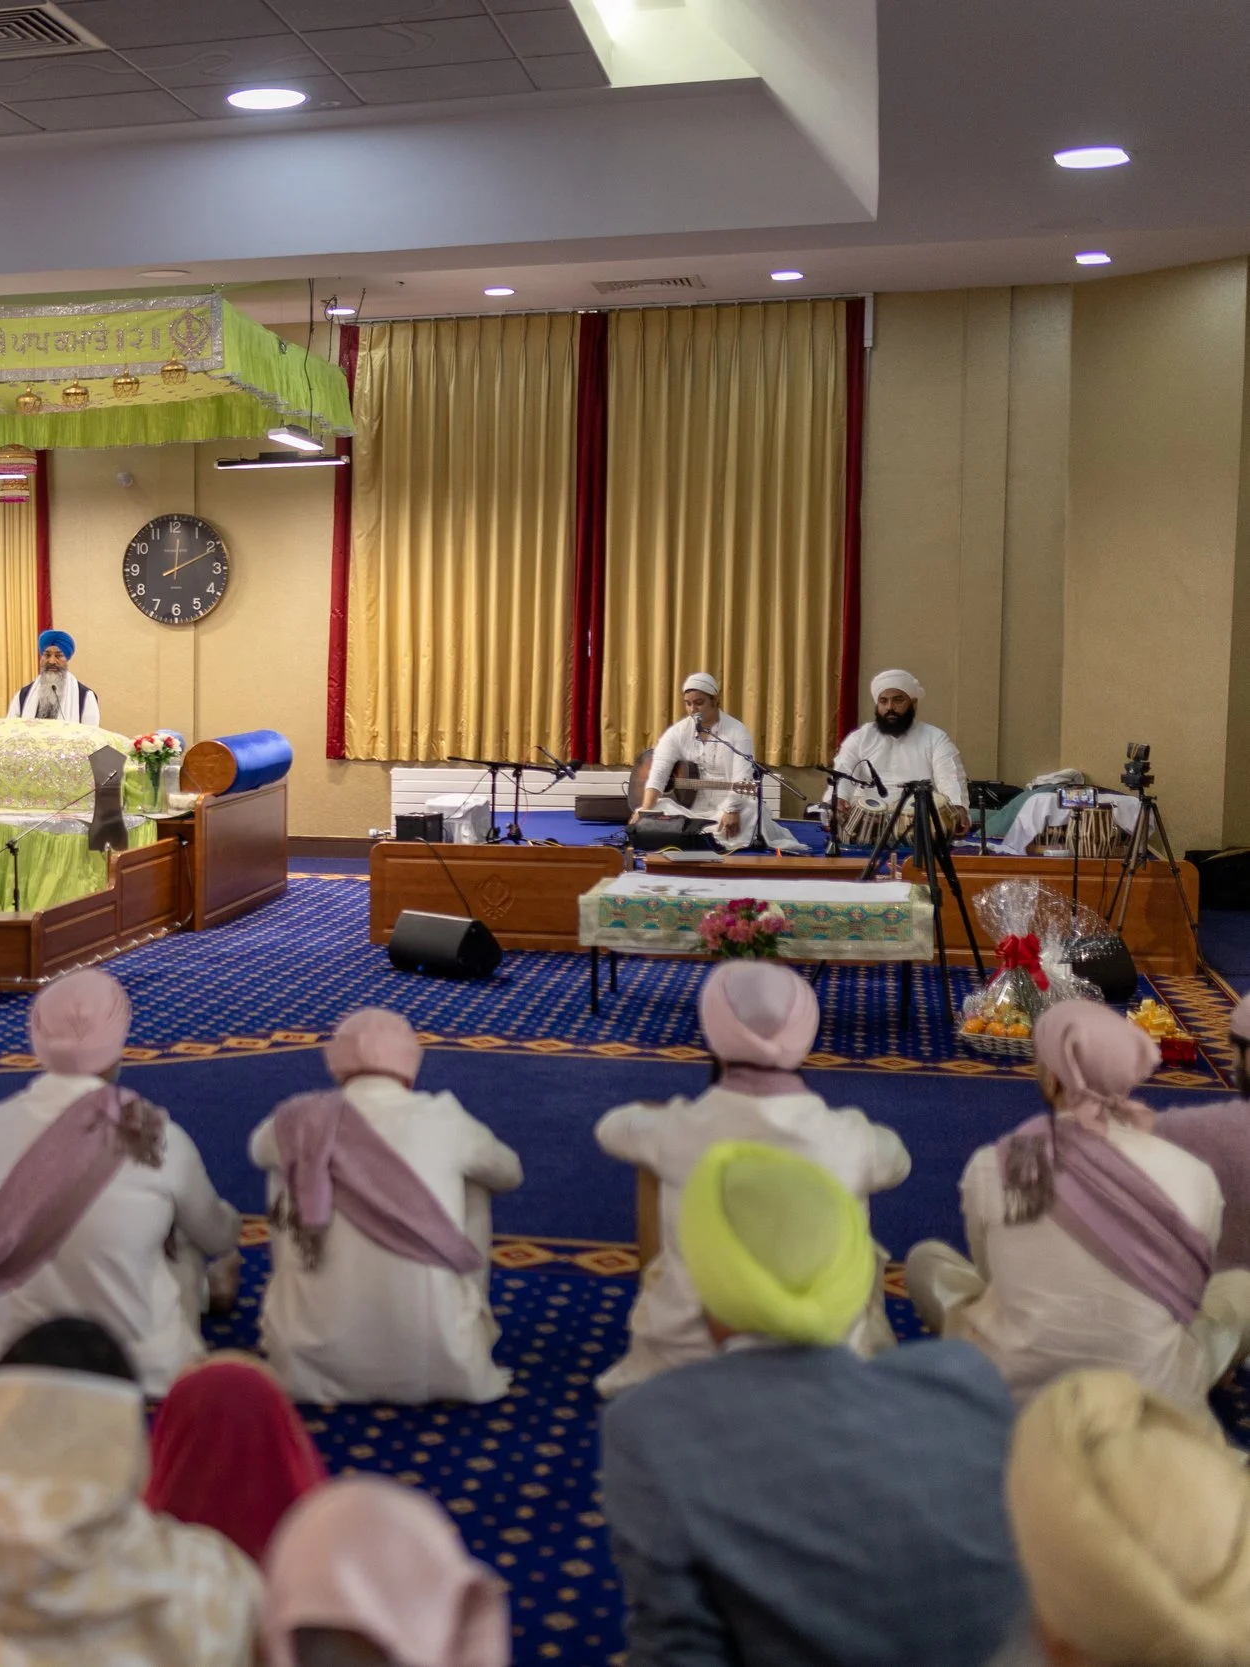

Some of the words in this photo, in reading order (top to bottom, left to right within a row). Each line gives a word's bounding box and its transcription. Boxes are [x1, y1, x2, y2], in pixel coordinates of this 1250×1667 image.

[152, 528, 160, 540] 11
[169, 521, 181, 534] 12
[137, 542, 149, 555] 10
[206, 540, 216, 553] 2
[131, 563, 140, 576] 9
[212, 562, 222, 575] 3
[137, 583, 145, 596] 8
[206, 582, 215, 595] 4
[152, 598, 161, 611] 7
[171, 604, 182, 616] 6
[192, 597, 202, 610] 5
